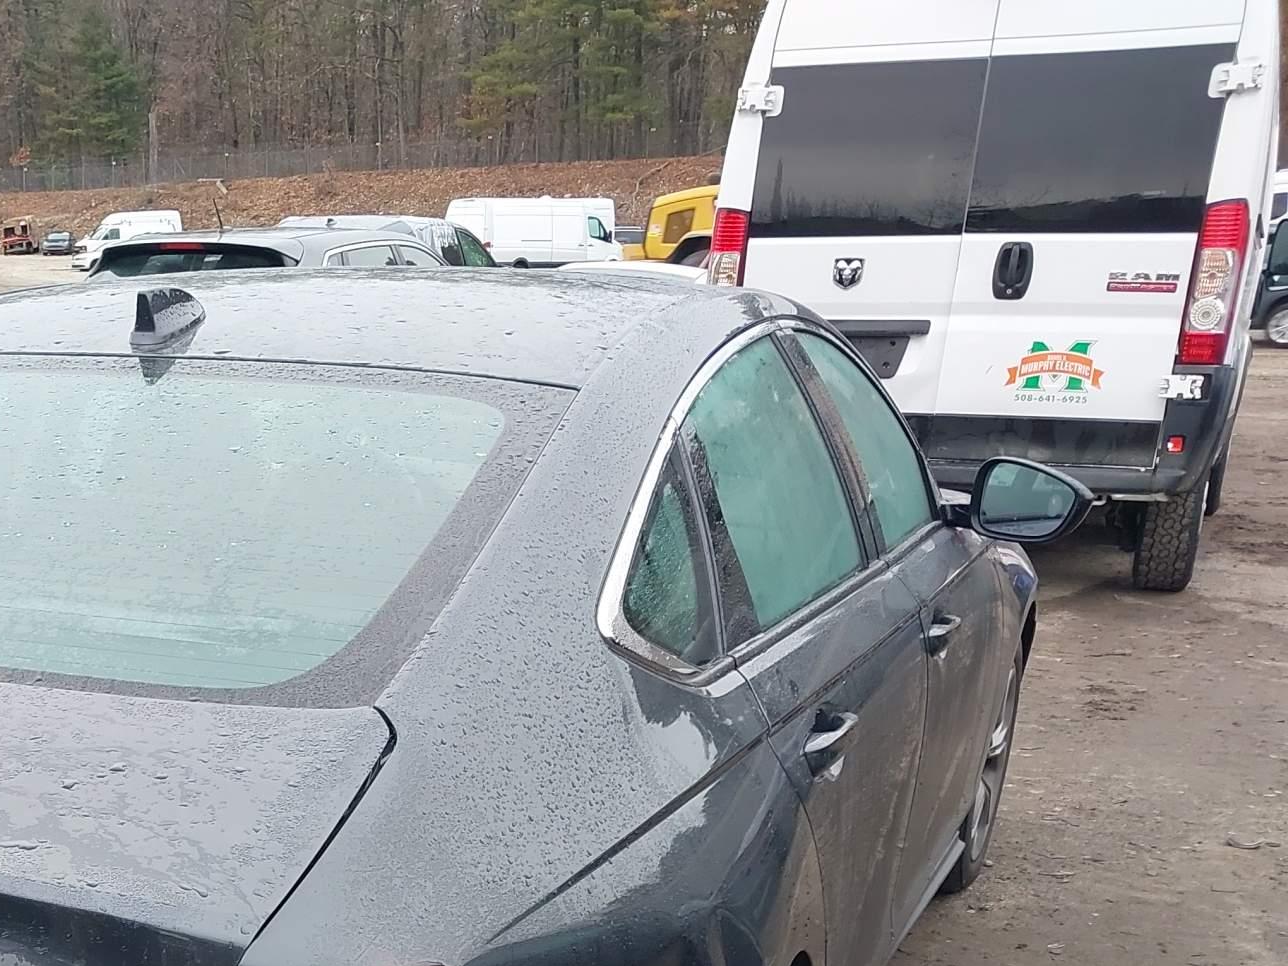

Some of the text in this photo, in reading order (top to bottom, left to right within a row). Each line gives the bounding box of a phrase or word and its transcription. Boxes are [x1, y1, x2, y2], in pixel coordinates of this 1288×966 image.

[1021, 360, 1091, 377] MURPHY ELECTRIC
[1014, 394, 1088, 404] 508-641-6925
